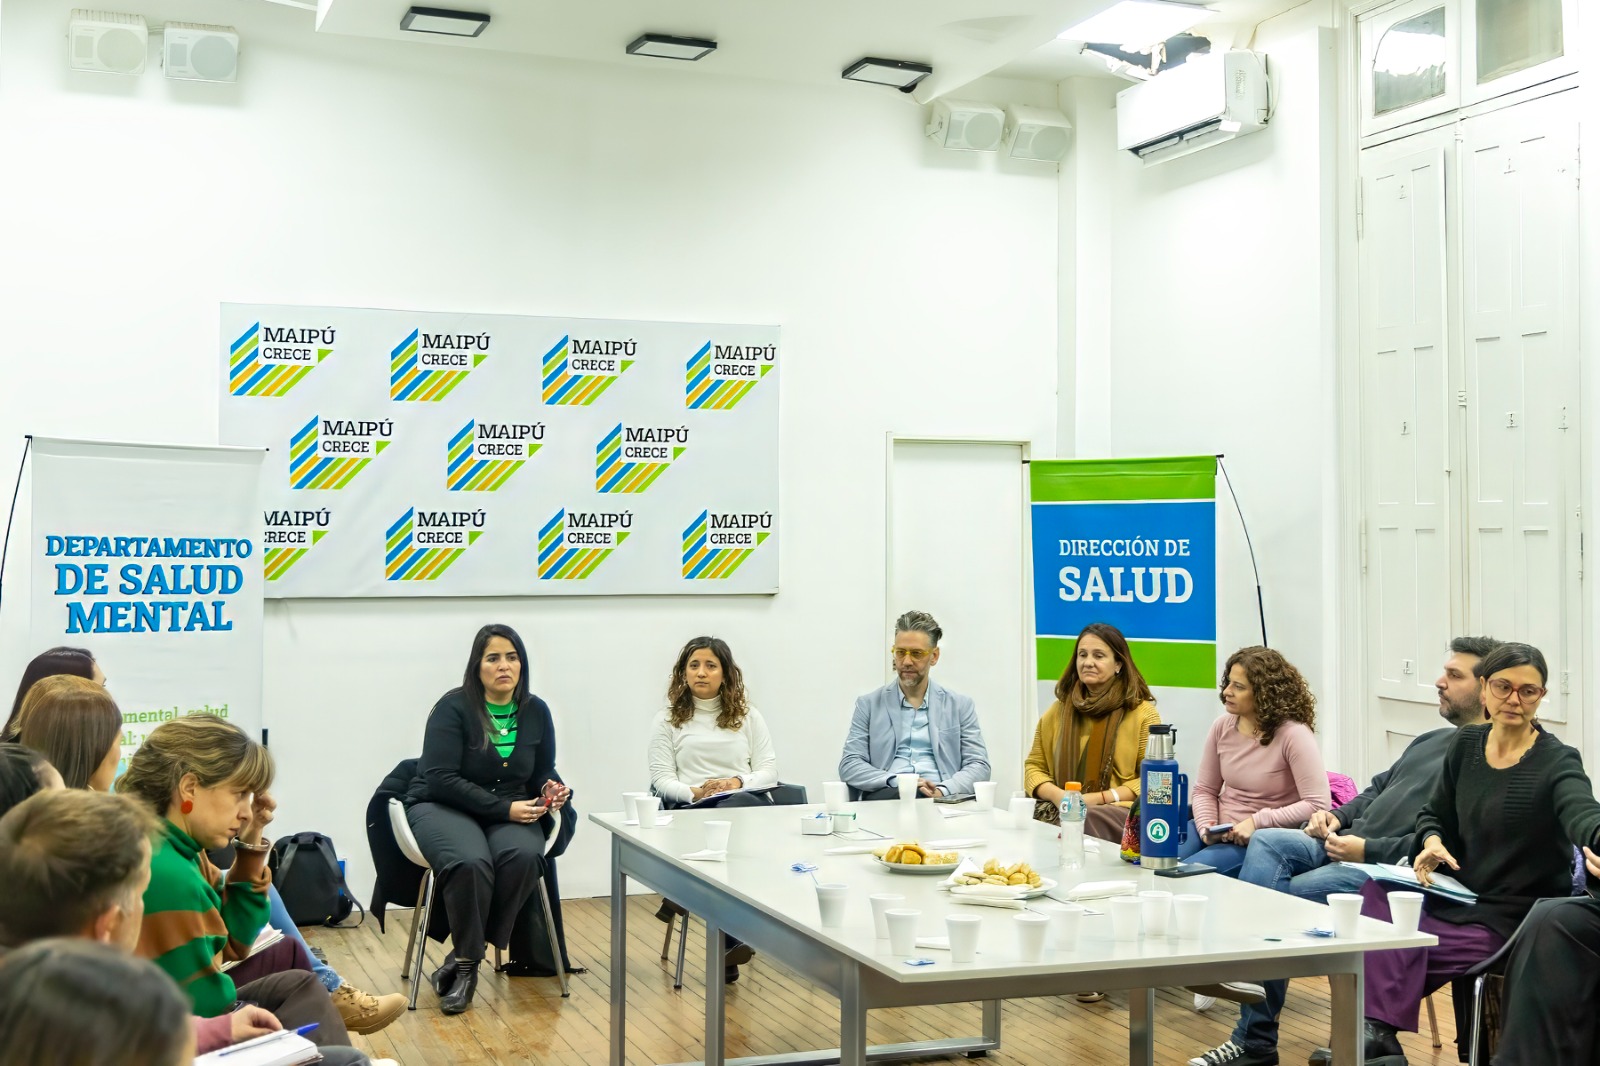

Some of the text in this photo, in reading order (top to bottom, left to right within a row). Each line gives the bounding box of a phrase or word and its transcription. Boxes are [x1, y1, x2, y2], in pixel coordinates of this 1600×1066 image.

[264, 326, 336, 344] MAIPÚ
[422, 332, 491, 350] MAIPÚ
[263, 348, 311, 360] CRECE
[572, 338, 637, 356] MAIPÚ
[714, 344, 776, 361] MAIPÚ
[421, 354, 468, 366] CRECE
[571, 359, 615, 371] CRECE
[714, 365, 756, 376] CRECE
[322, 419, 394, 436] MAIPÚ
[478, 422, 545, 440] MAIPÚ
[625, 426, 689, 443] MAIPÚ
[322, 441, 370, 453] CRECE
[477, 444, 523, 455] CRECE
[625, 447, 668, 458] CRECE
[417, 509, 486, 527] MAIPÚ
[568, 510, 633, 528] MAIPÚ
[711, 511, 772, 528] MAIPÚ
[46, 535, 253, 558] DEPARTAMENTO
[417, 532, 463, 544] CRECE
[568, 533, 611, 544] CRECE
[710, 534, 752, 544] CRECE
[1059, 535, 1190, 556] DIRECCIÓN DE
[55, 563, 244, 595] DE SALUD
[1059, 566, 1194, 603] SALUD
[66, 600, 233, 634] MENTAL
